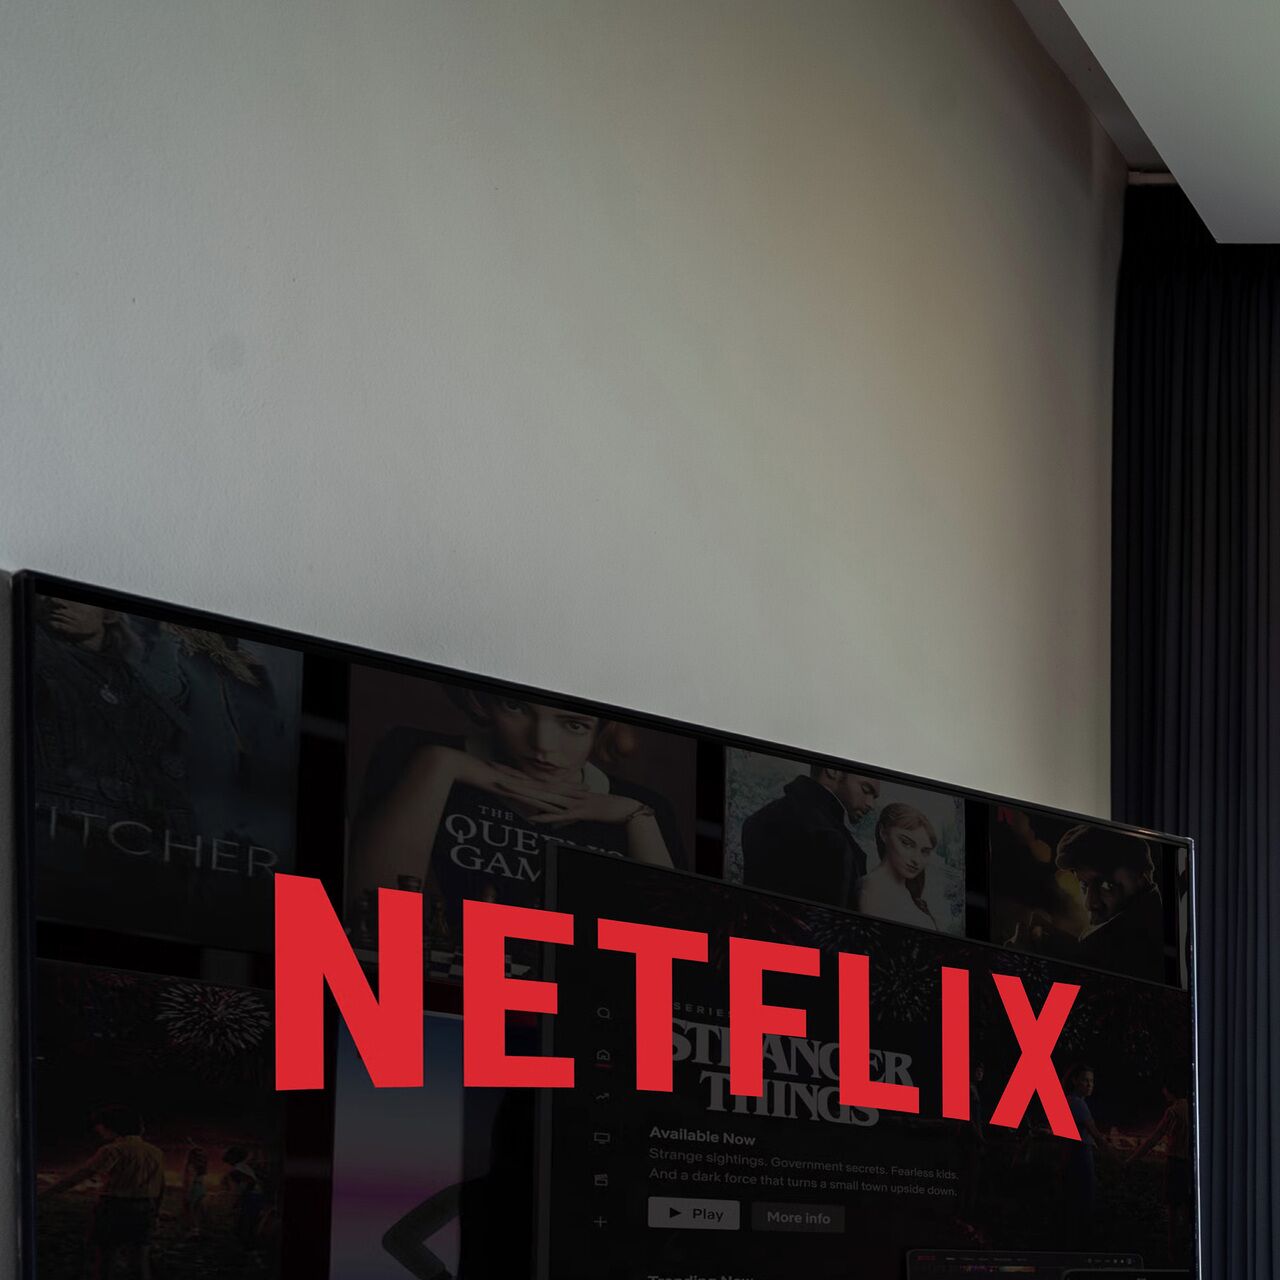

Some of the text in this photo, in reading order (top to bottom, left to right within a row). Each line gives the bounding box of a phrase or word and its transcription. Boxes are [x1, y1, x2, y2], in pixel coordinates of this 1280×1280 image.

[478, 804, 515, 822] THE
[36, 803, 279, 877] ITCHER
[275, 872, 1081, 1141] NETFLIX
[673, 1002, 729, 1017] SERIE
[649, 1126, 757, 1146] Available Now
[649, 1148, 703, 1164] Strange
[705, 1152, 768, 1168] sightings.
[770, 1156, 844, 1173] Government
[891, 1166, 934, 1178] Fearless
[649, 1167, 678, 1180] And
[680, 1171, 689, 1181] a
[692, 1170, 721, 1183] dark
[724, 1172, 757, 1185] force
[760, 1175, 785, 1186] that
[787, 1177, 818, 1189] turns
[819, 1180, 828, 1189] a
[829, 1179, 859, 1191] small
[861, 1182, 888, 1193] town
[890, 1184, 926, 1196] upside
[692, 1207, 725, 1223] Play
[767, 1211, 832, 1225] More info
